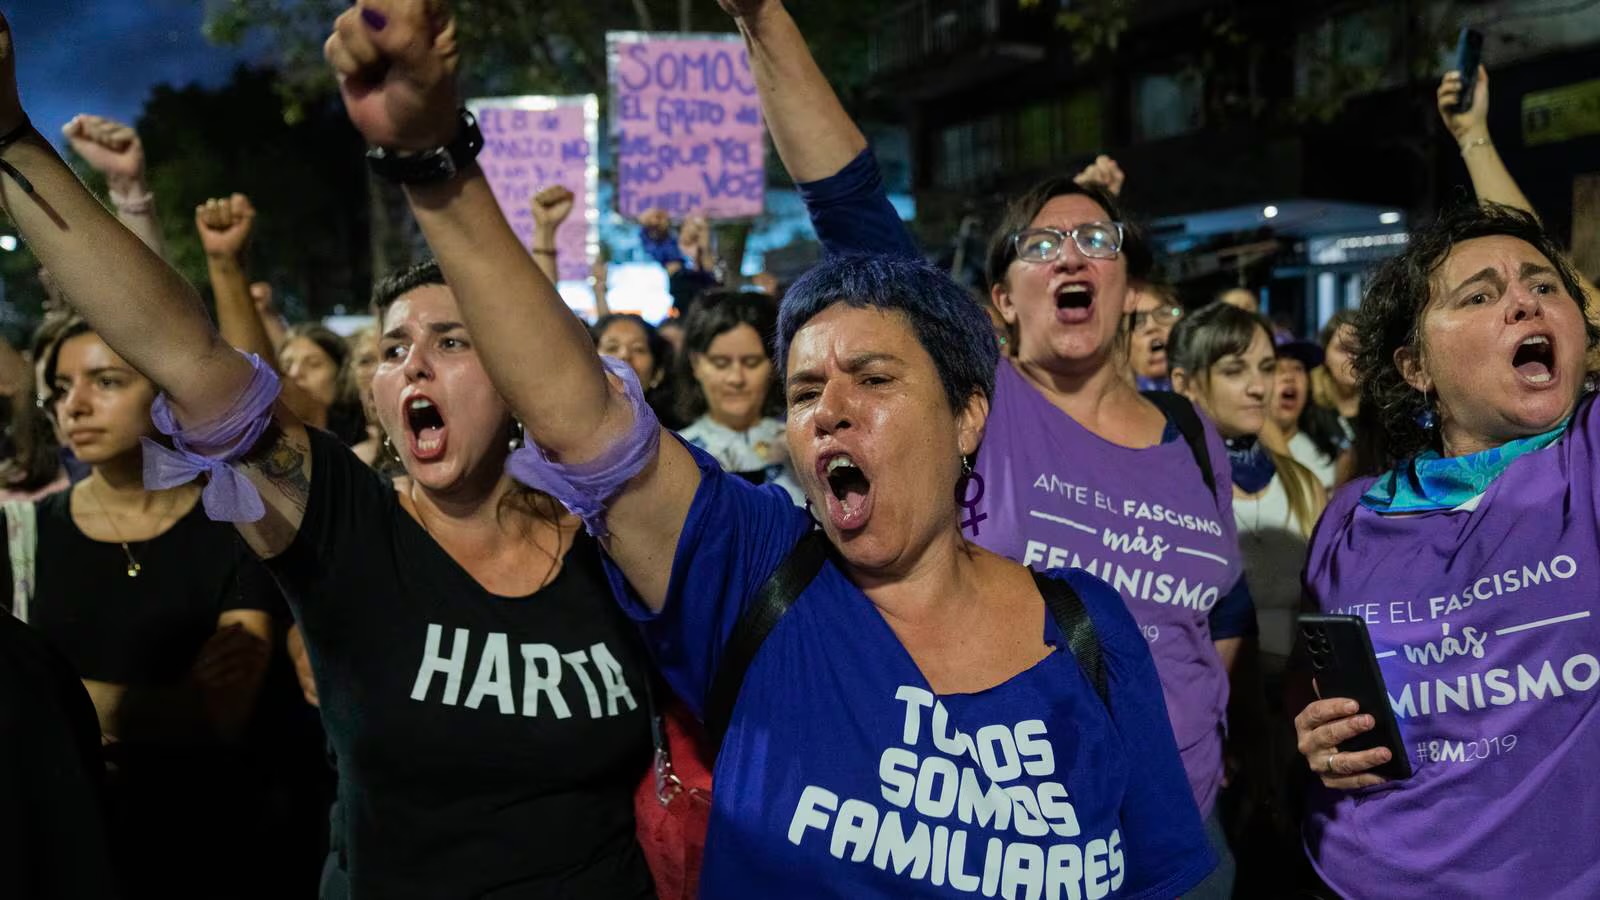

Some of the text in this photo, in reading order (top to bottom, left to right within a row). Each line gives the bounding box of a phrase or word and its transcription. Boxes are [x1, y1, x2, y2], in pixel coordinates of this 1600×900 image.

[621, 43, 756, 96] SOMOS
[621, 94, 648, 121] EL
[621, 161, 662, 184] NO
[1033, 473, 1222, 537] ANTE EL FASCISMO
[1329, 554, 1577, 624] TE EL FASCISMO
[410, 623, 638, 719] HARTA
[1416, 734, 1518, 763] #8M2019
[879, 747, 1081, 837] SOMOS
[787, 785, 1125, 900] FAMILIARES
